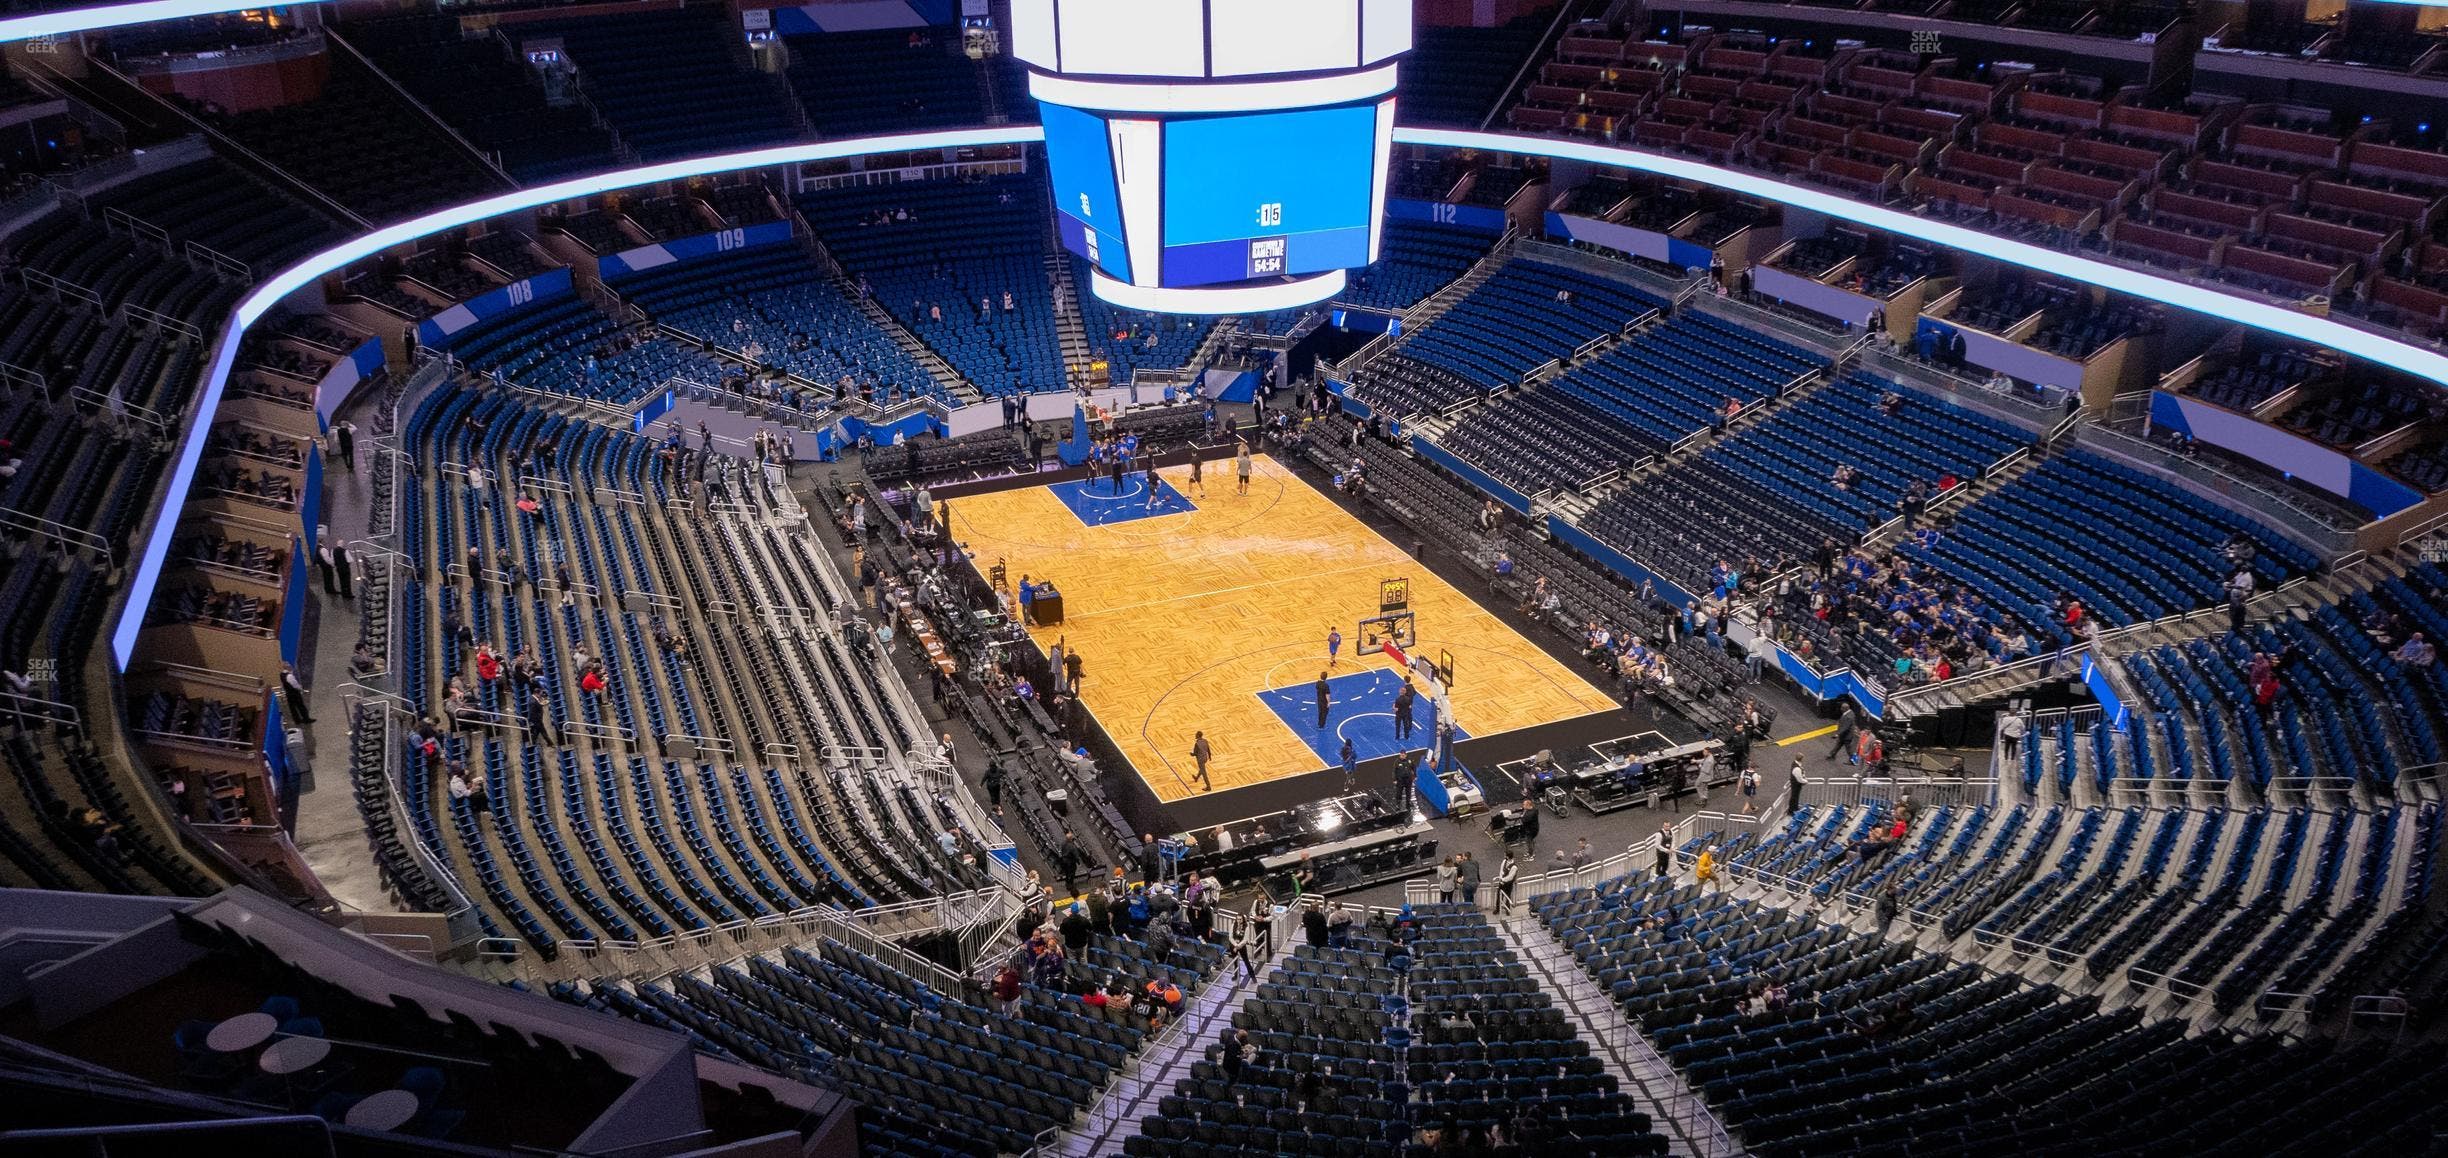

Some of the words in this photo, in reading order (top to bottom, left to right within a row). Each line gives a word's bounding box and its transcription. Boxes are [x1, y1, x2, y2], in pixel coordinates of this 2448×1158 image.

[1432, 202, 1457, 224] 112
[715, 228, 745, 252] 109
[1254, 257, 1280, 273] 54:54
[507, 279, 533, 307] 108
